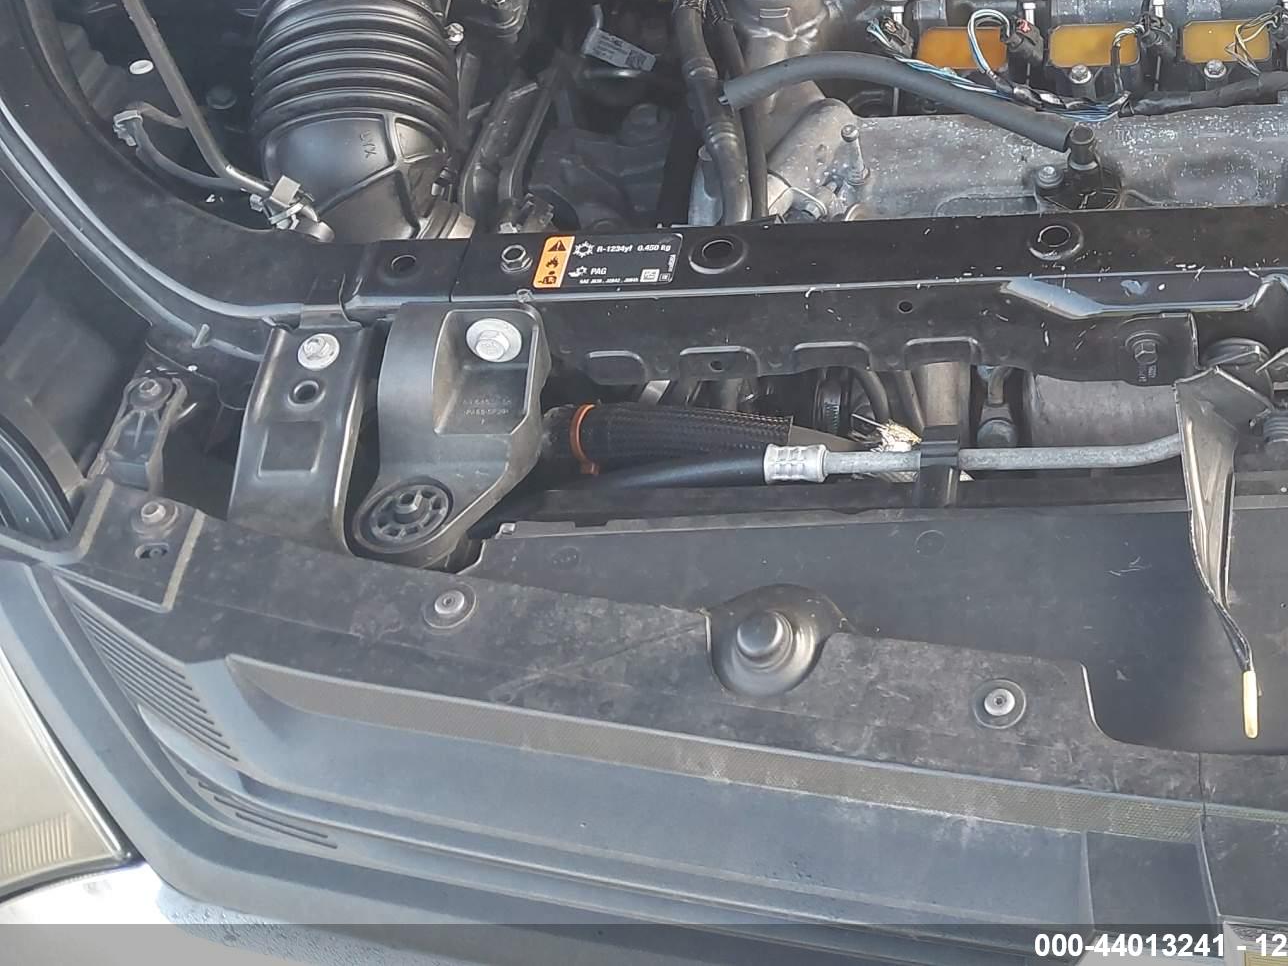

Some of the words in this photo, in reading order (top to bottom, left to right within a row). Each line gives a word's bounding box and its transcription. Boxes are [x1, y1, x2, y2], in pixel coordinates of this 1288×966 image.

[596, 244, 634, 253] R-1234yf
[637, 244, 659, 252] 0.450
[660, 244, 672, 252] kg
[590, 267, 607, 275] PAG
